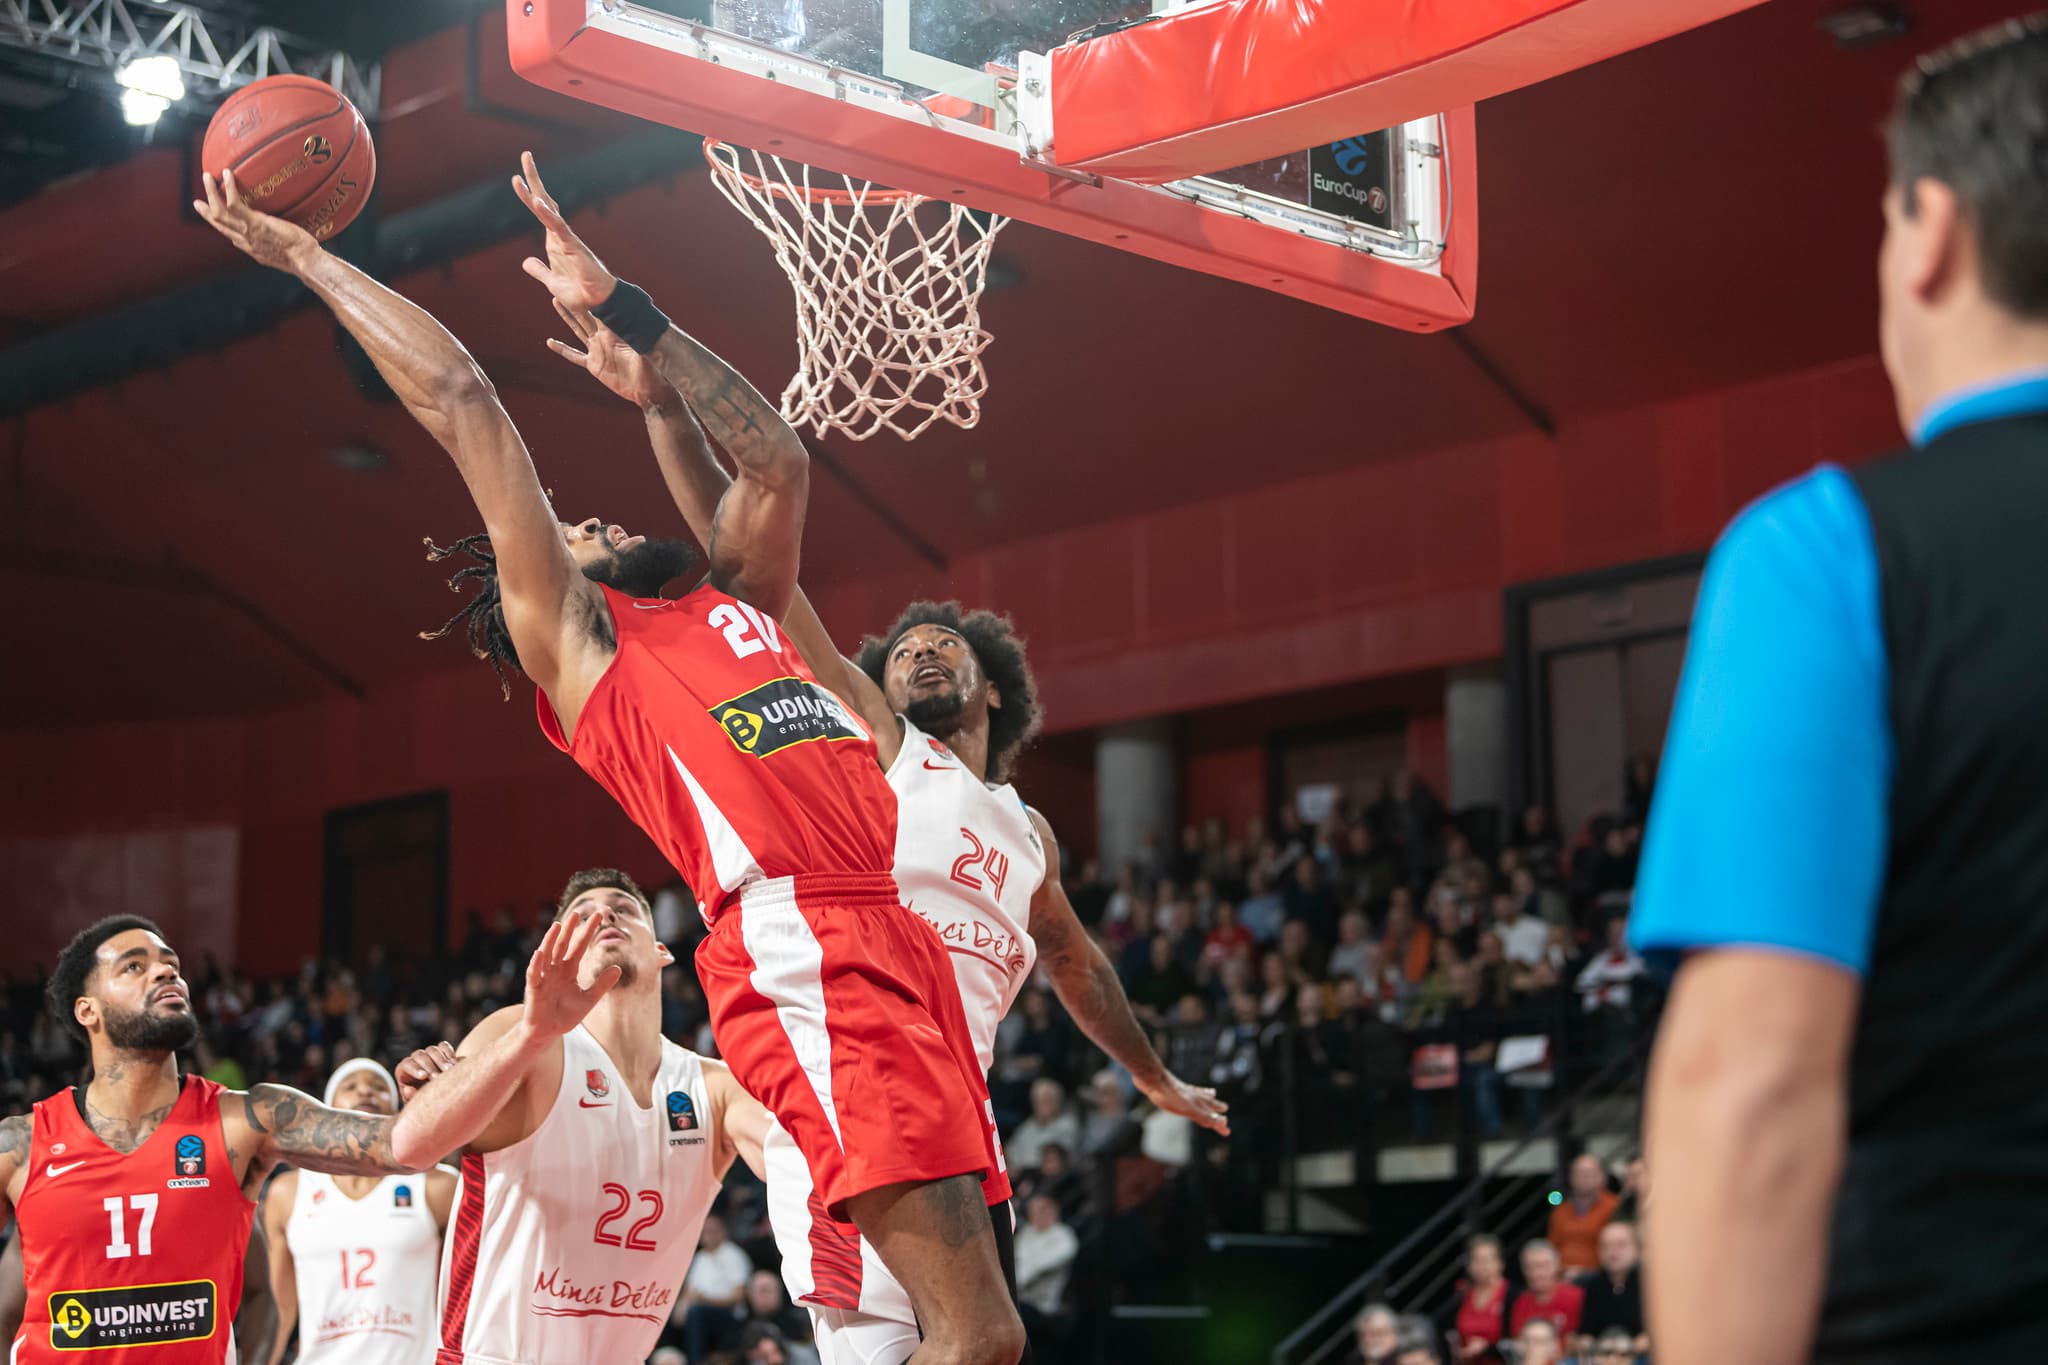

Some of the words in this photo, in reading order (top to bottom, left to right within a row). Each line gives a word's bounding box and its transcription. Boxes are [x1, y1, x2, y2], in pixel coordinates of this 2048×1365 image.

[1312, 173, 1368, 205] EuroCup
[949, 826, 1009, 905] 24
[103, 1193, 159, 1259] 17
[593, 1182, 664, 1252] 22
[340, 1247, 377, 1290] 12
[534, 1267, 606, 1305] Minci
[99, 1321, 196, 1338] engineering
